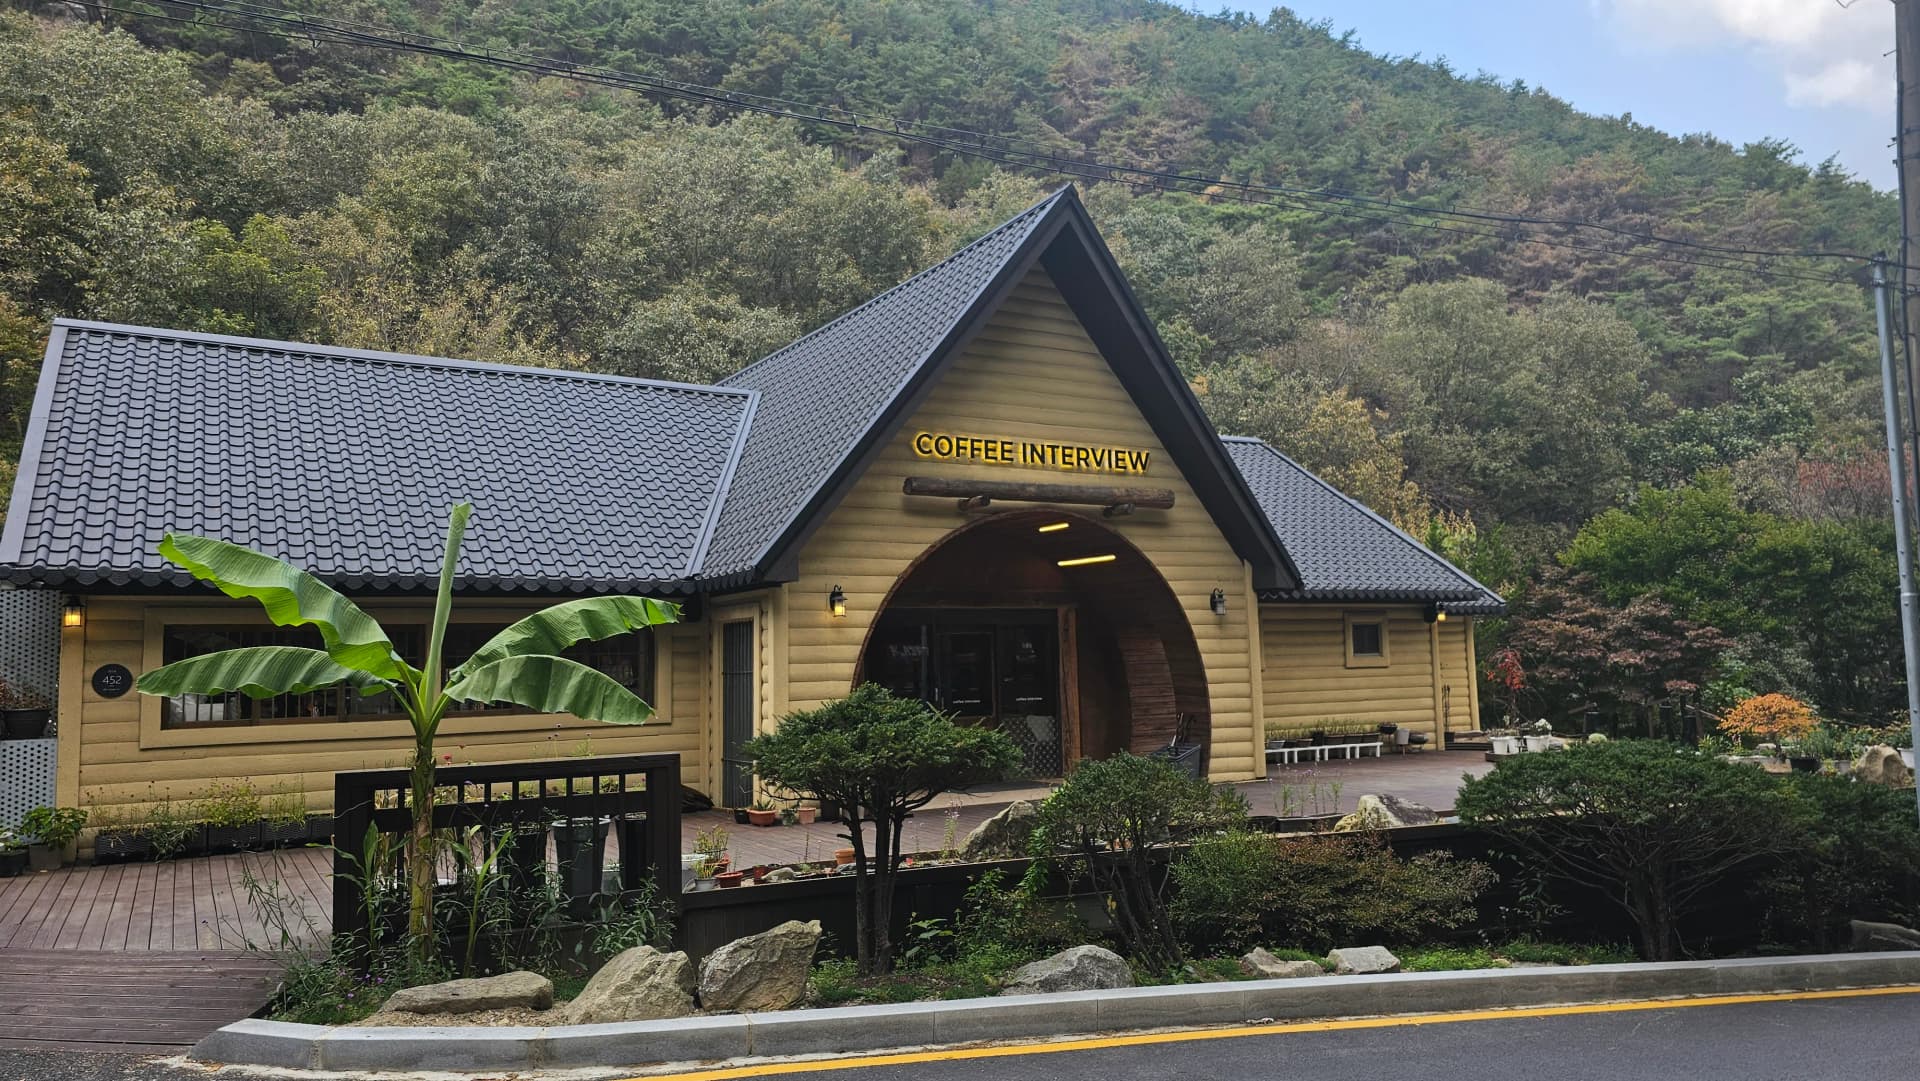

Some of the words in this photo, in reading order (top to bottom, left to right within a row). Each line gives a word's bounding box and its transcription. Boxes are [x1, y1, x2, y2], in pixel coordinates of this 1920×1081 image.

[916, 433, 1014, 462] COFFEE
[1022, 442, 1150, 471] INTERVIEW
[102, 675, 122, 685] 452
